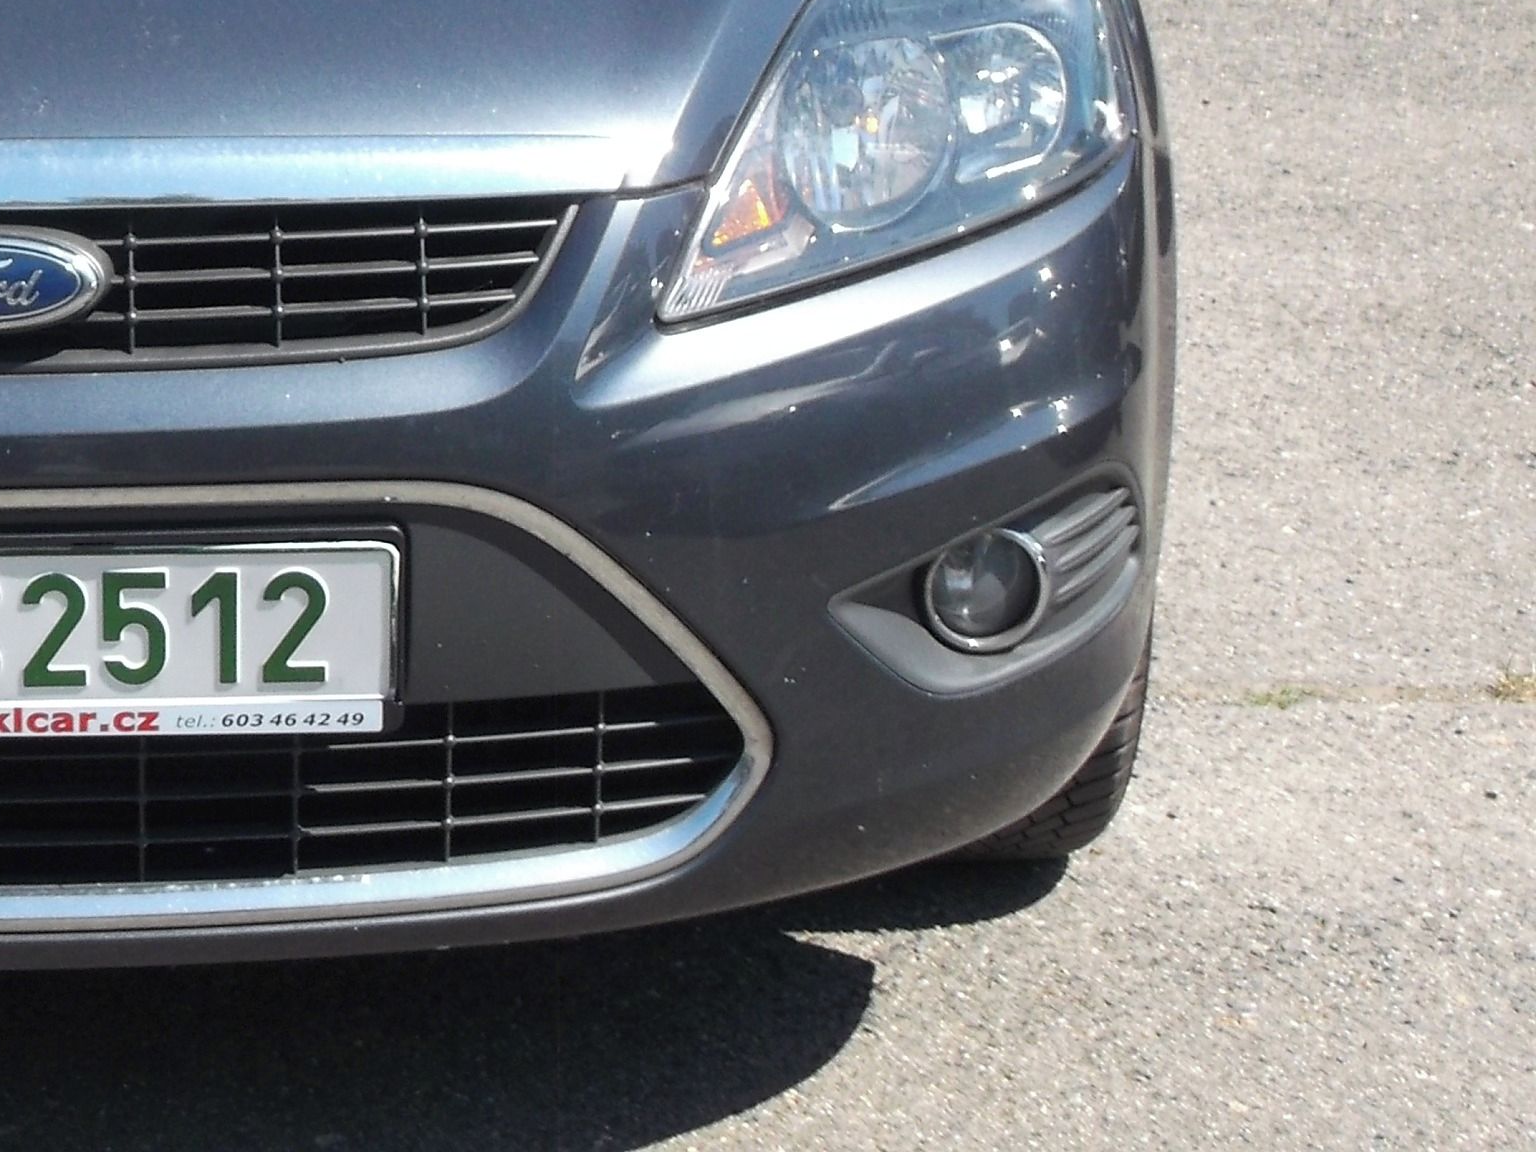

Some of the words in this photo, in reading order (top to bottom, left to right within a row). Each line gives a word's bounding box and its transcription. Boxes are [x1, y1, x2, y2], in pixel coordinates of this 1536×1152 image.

[20, 572, 328, 688] 2512
[175, 714, 215, 728] tel.:
[221, 713, 264, 728] 603
